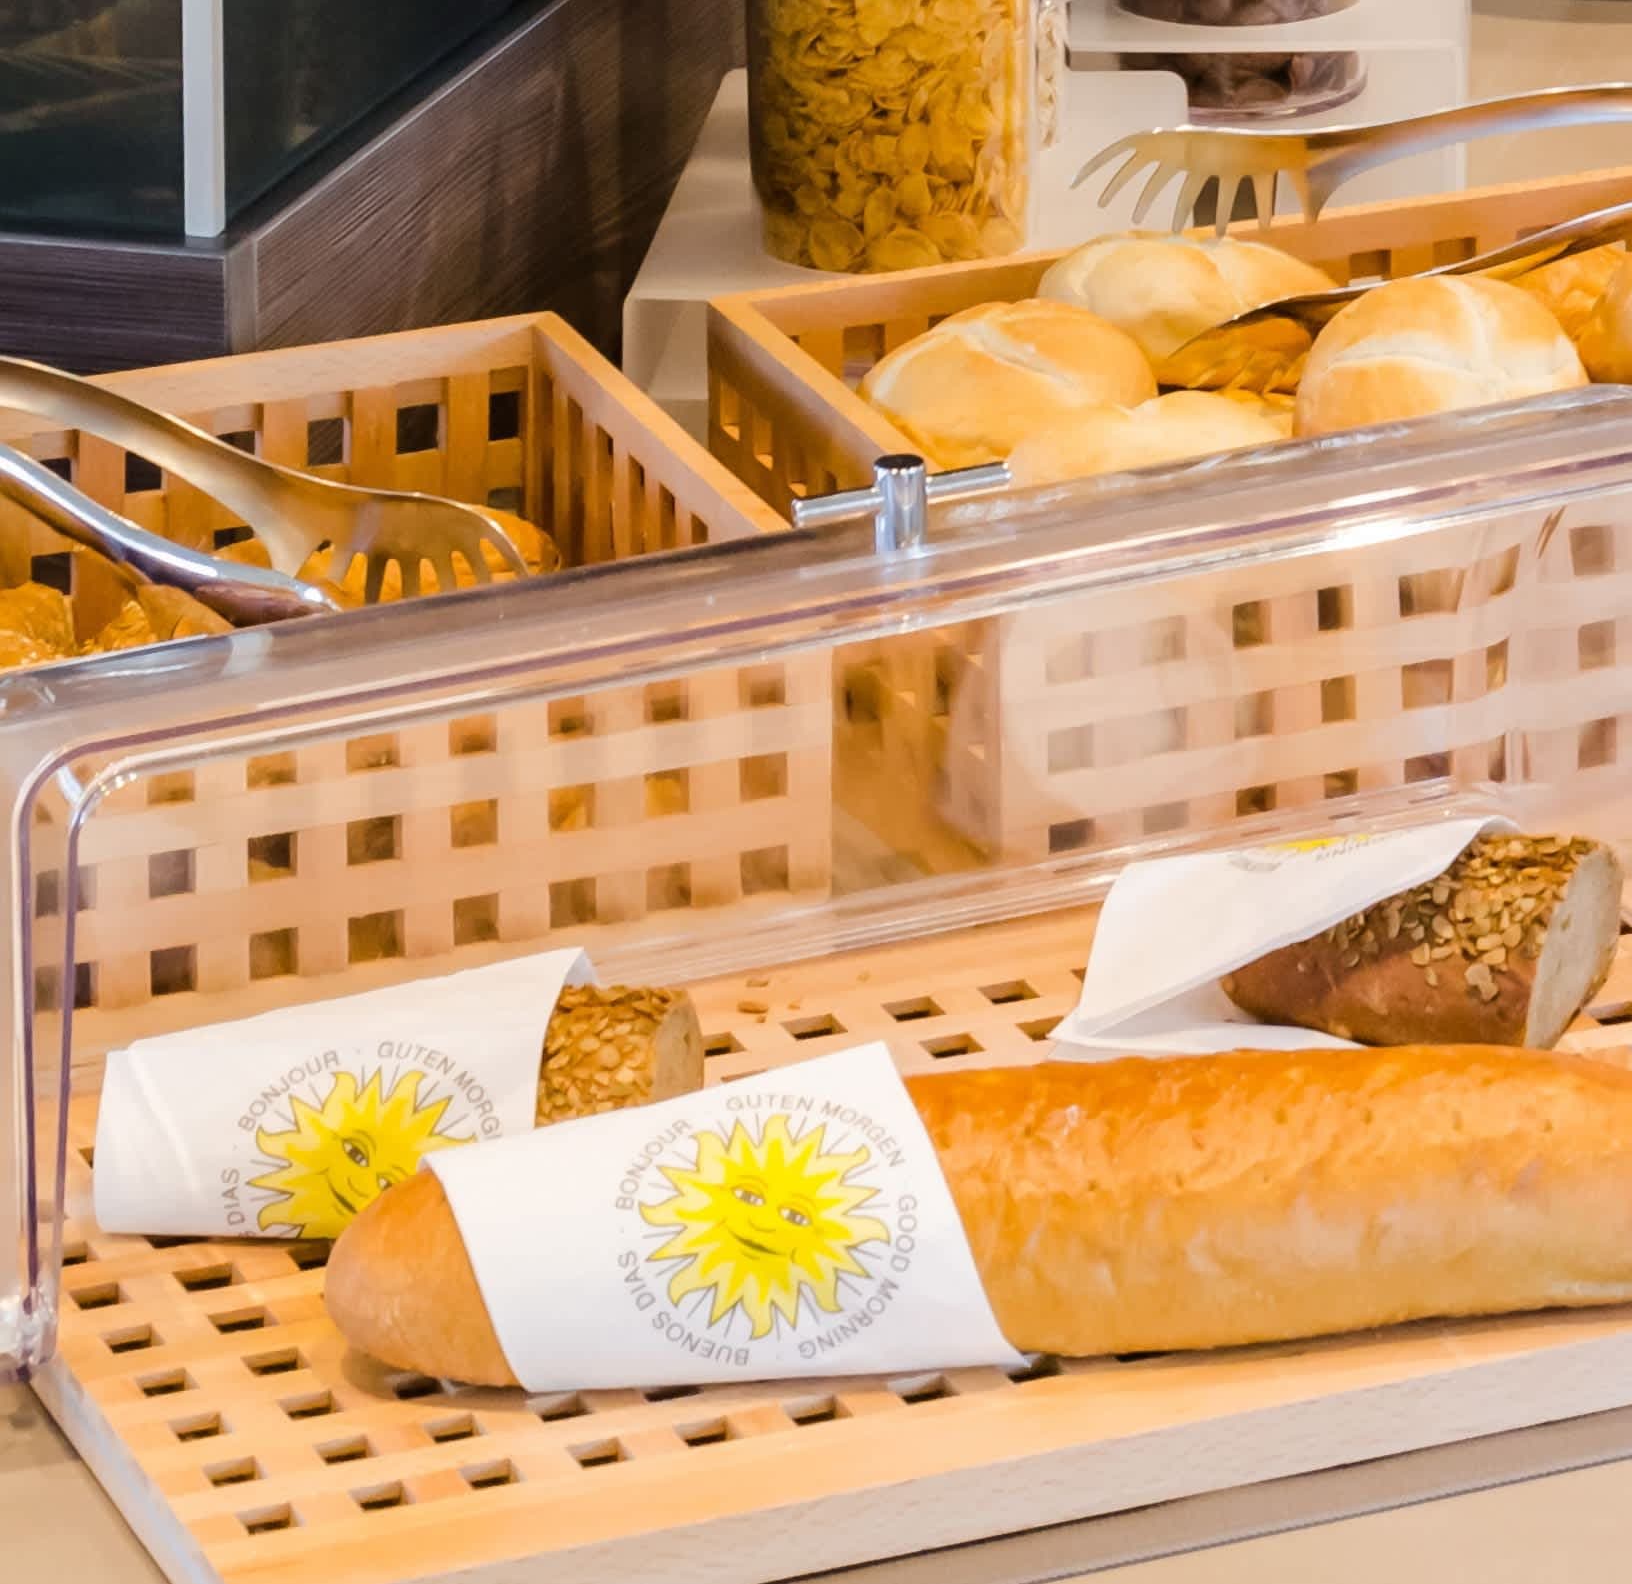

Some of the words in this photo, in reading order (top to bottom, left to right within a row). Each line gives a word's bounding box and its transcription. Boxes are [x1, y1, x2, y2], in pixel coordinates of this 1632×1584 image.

[237, 1049, 341, 1133] BONJOUR
[376, 1039, 456, 1076] GUTEN
[453, 1070, 503, 1140] MORG
[615, 1118, 693, 1211] BONJOUR
[725, 1093, 816, 1113] GUTEN
[820, 1100, 905, 1167] MORGEN
[221, 1167, 246, 1226] DIAS
[887, 1193, 919, 1273] GOOD
[616, 1250, 657, 1311] DIAS
[797, 1279, 900, 1359] MORNING
[651, 1310, 750, 1367] BUENOS
